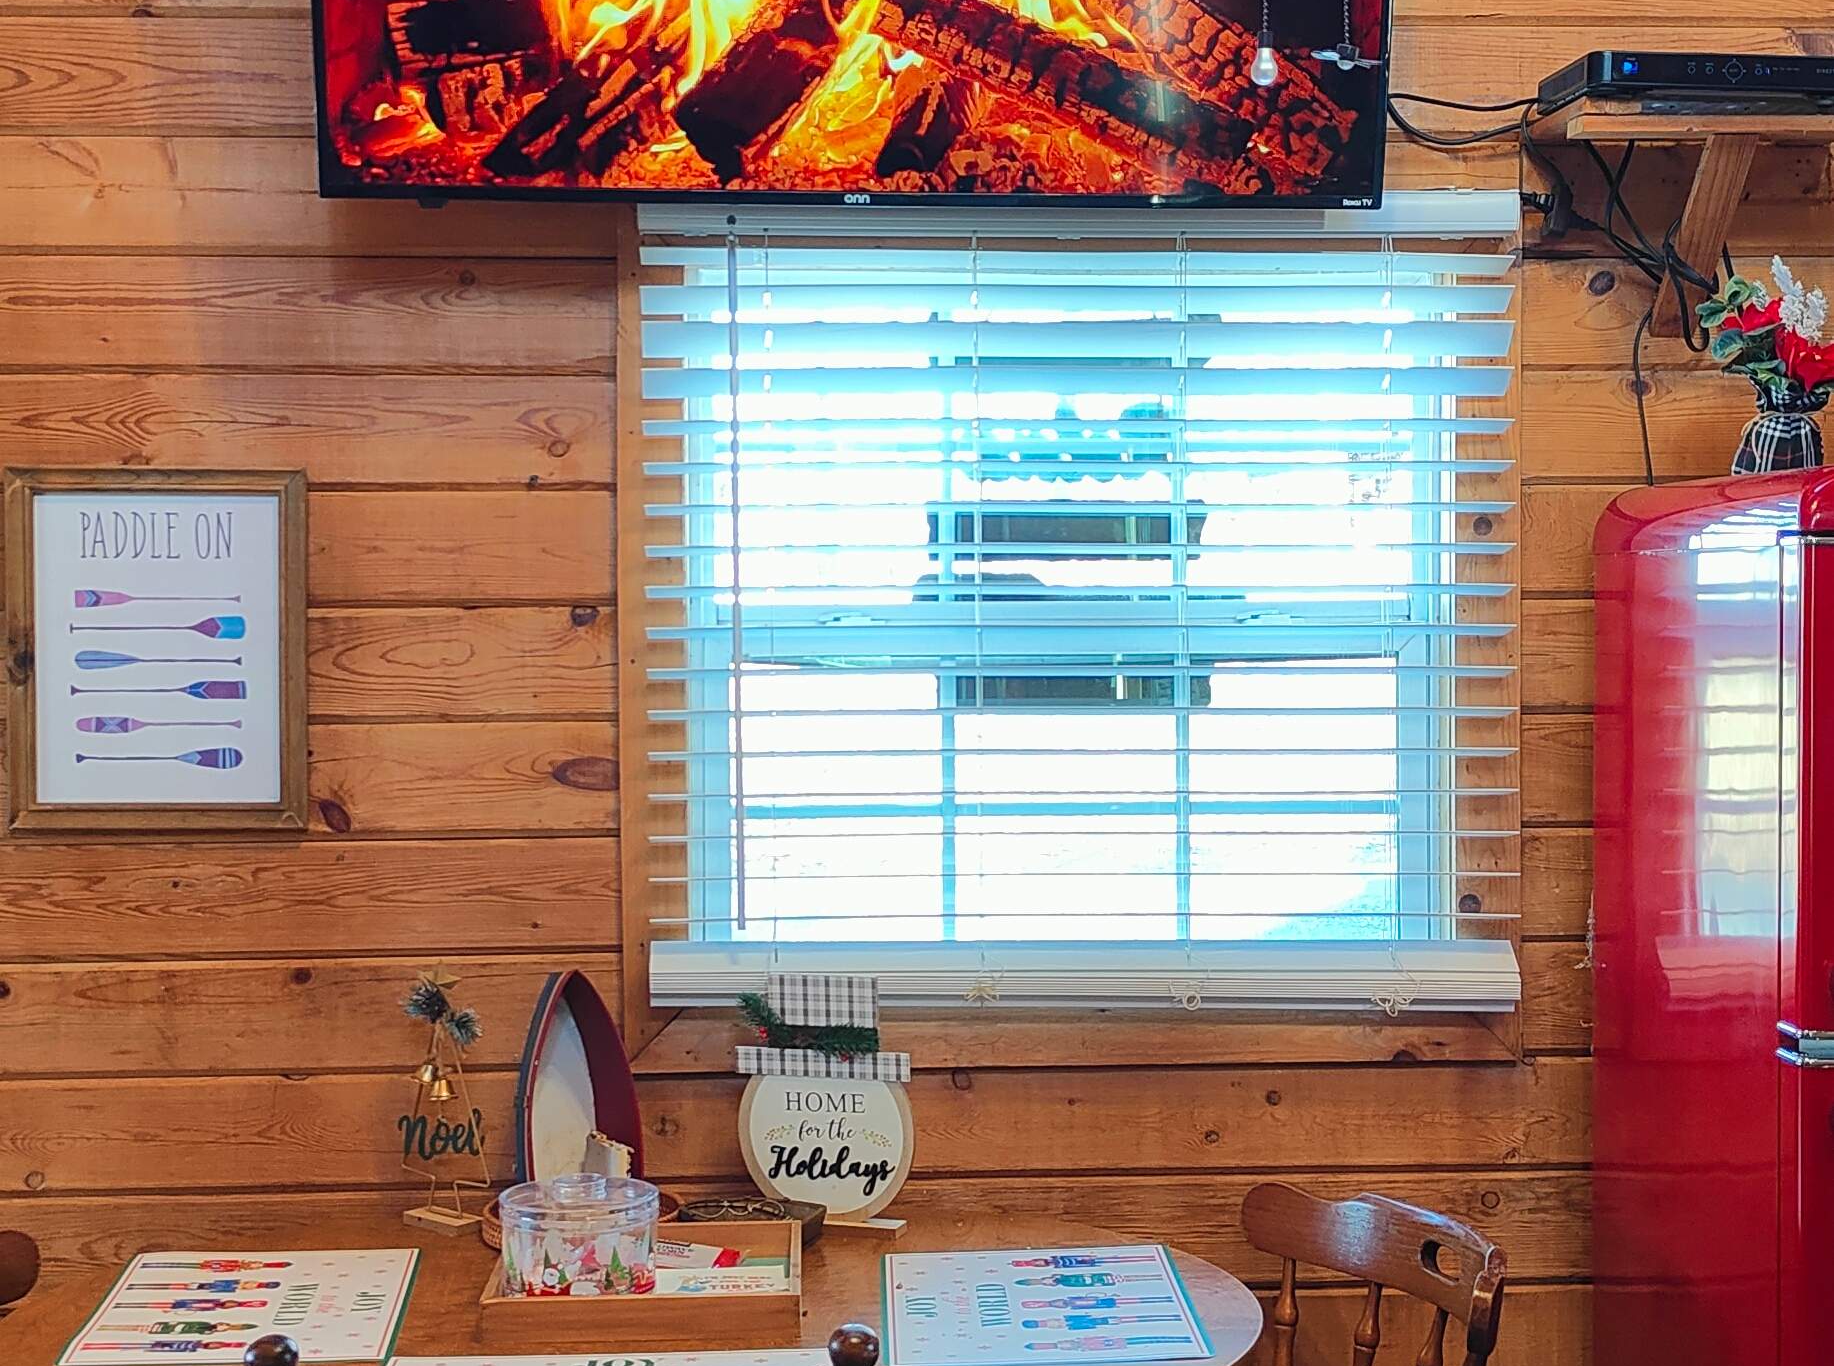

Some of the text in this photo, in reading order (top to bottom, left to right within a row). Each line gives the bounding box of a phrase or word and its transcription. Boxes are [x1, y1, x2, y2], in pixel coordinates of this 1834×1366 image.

[844, 193, 870, 204] onn
[1362, 198, 1373, 206] TV
[79, 511, 233, 559] PADDLE ON
[785, 1091, 866, 1114] HOME
[798, 1117, 857, 1142] for the
[768, 1144, 896, 1197] Holidays
[709, 1283, 776, 1291] TURKEY
[272, 1283, 320, 1326] WORLD
[350, 1291, 387, 1313] JOY
[905, 1295, 938, 1318] JOY
[976, 1283, 1013, 1327] WORLD
